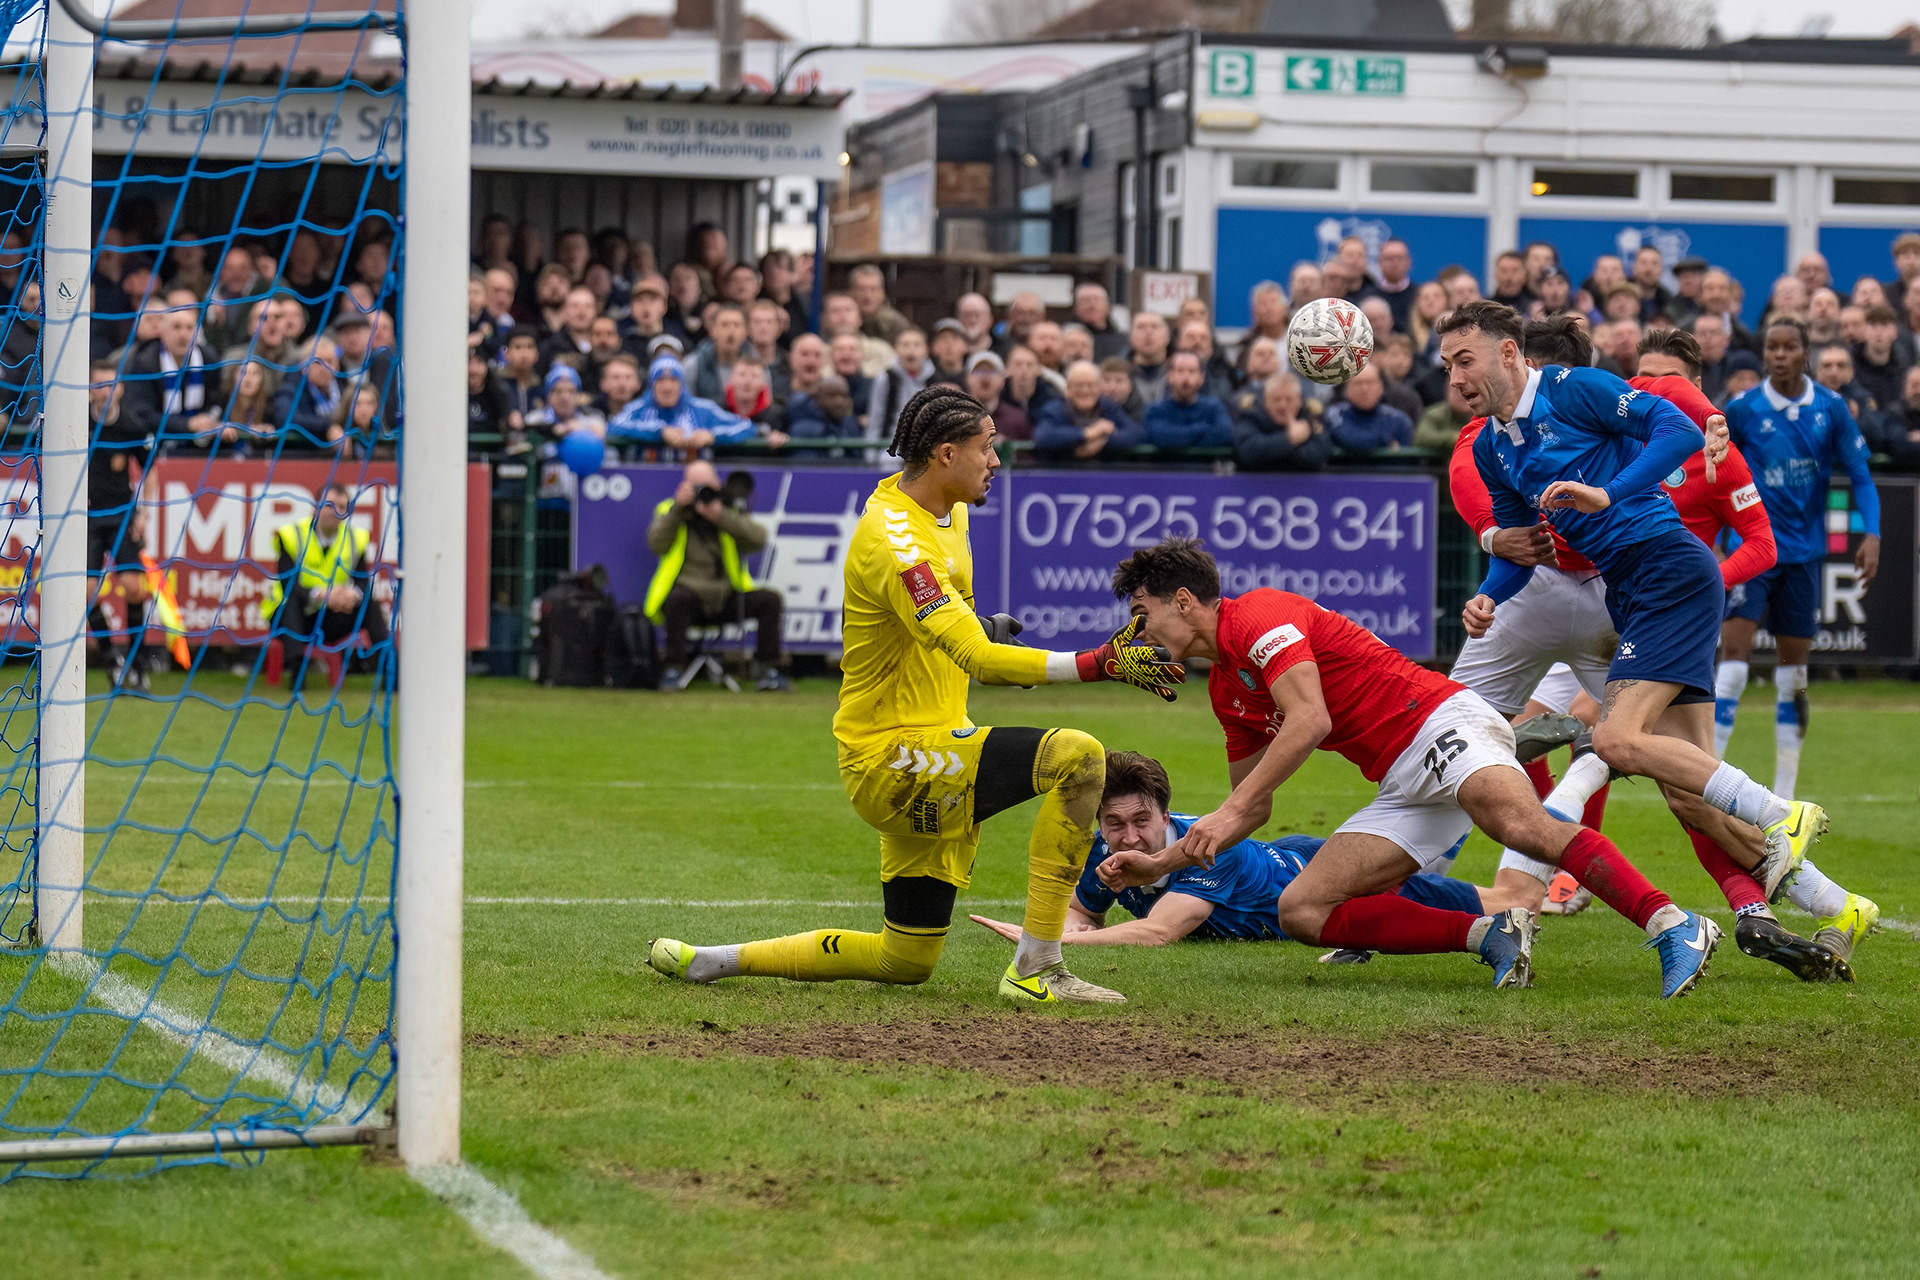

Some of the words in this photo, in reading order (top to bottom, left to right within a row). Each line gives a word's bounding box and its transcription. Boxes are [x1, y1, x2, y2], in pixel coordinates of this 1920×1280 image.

[1216, 53, 1249, 92] B
[120, 94, 152, 134] &
[168, 97, 342, 141] Laminate
[1149, 280, 1190, 301] EXIT
[1017, 491, 1199, 548] 07525
[1209, 495, 1321, 550] 538
[1331, 496, 1424, 551] 341
[1253, 634, 1289, 664] Kress
[1424, 729, 1469, 785] 25
